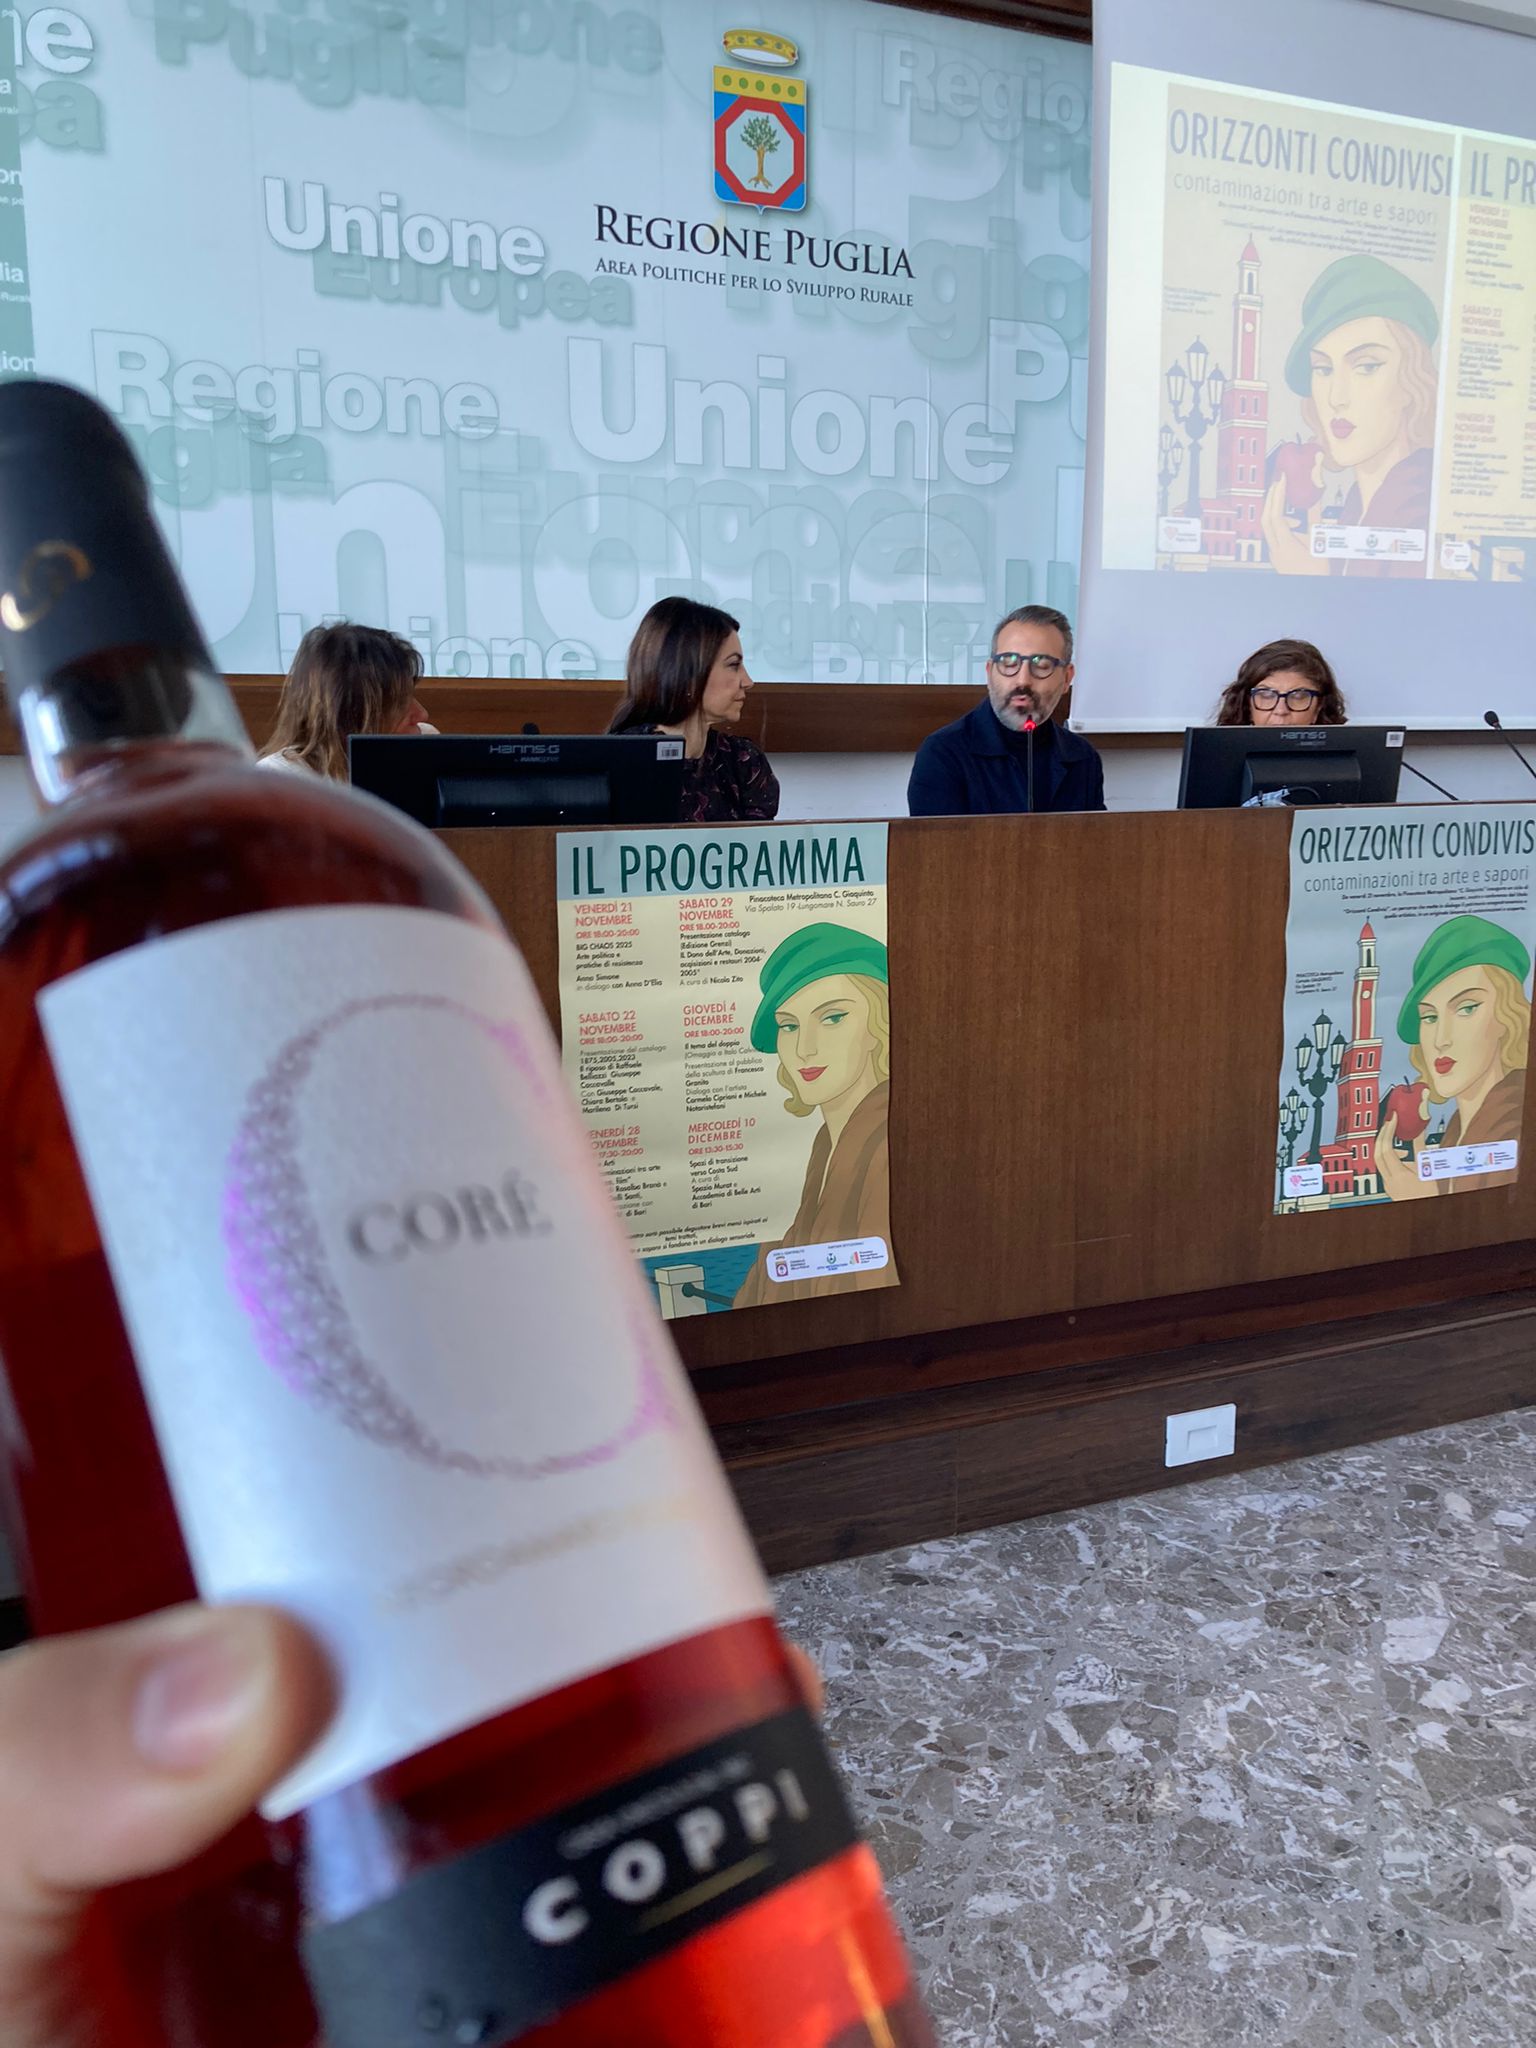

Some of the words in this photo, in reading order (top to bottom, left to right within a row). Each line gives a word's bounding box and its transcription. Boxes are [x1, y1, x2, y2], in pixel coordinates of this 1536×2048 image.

[1169, 108, 1316, 175] ORIZZONTI
[1327, 136, 1452, 197] CONDIVISI
[1470, 150, 1494, 197] IL
[1174, 172, 1303, 205] contaminazioni
[1309, 191, 1330, 211] tra
[1336, 197, 1368, 217] arte
[1373, 201, 1383, 218] e
[1388, 204, 1438, 227] sapori
[263, 176, 546, 277] Unione
[594, 204, 771, 262] REGIONE
[784, 228, 916, 279] PUGLIA
[596, 257, 637, 277] AREA
[643, 262, 726, 286] POLITICHE
[786, 279, 855, 300] SVILUPPO
[860, 288, 914, 307] RURALE
[92, 329, 499, 445] Regione
[567, 336, 1014, 486] Unione
[1301, 824, 1425, 864] ORIZZONTI
[1432, 819, 1536, 857] CONDIVIS
[573, 846, 605, 895] IL
[620, 837, 865, 892] PROGRAMMA
[1304, 871, 1414, 892] contaminazioni
[1418, 871, 1437, 886] tra
[1442, 869, 1468, 884] arte
[1473, 869, 1480, 882] e
[1484, 866, 1529, 885] sapori
[749, 895, 784, 903] Pinacoteca
[787, 892, 832, 901] Metropolitana
[843, 890, 874, 898] Giaquinto
[621, 903, 632, 912] 21
[680, 898, 718, 909] SABATO
[721, 897, 732, 907] 29
[758, 904, 784, 914] Spalato
[847, 899, 865, 907] Sauro
[868, 898, 876, 906] 27
[575, 915, 632, 926] NOVEMBRE
[680, 909, 733, 921] NOVEMBRE
[576, 931, 591, 939] ORE
[725, 930, 750, 938] catalogo
[730, 1002, 736, 1011] 4
[580, 1012, 620, 1023] SABATO
[623, 1010, 635, 1020] 22
[684, 1014, 734, 1026] DICEMBRE
[580, 1023, 636, 1036] NOVEMBRE
[685, 1061, 727, 1069] Presentazione
[736, 1058, 762, 1066] pubblico
[702, 1069, 725, 1077] scultura
[745, 1118, 755, 1127] 10
[628, 1125, 640, 1135] 28
[591, 1137, 639, 1149] OVEMBRE
[688, 1130, 742, 1144] DICEMBRE
[716, 1156, 748, 1164] transizione
[727, 1165, 738, 1173] Sud
[692, 1185, 712, 1193] Spazio
[692, 1192, 725, 1200] Accademia
[522, 1768, 809, 1945] COPPI
